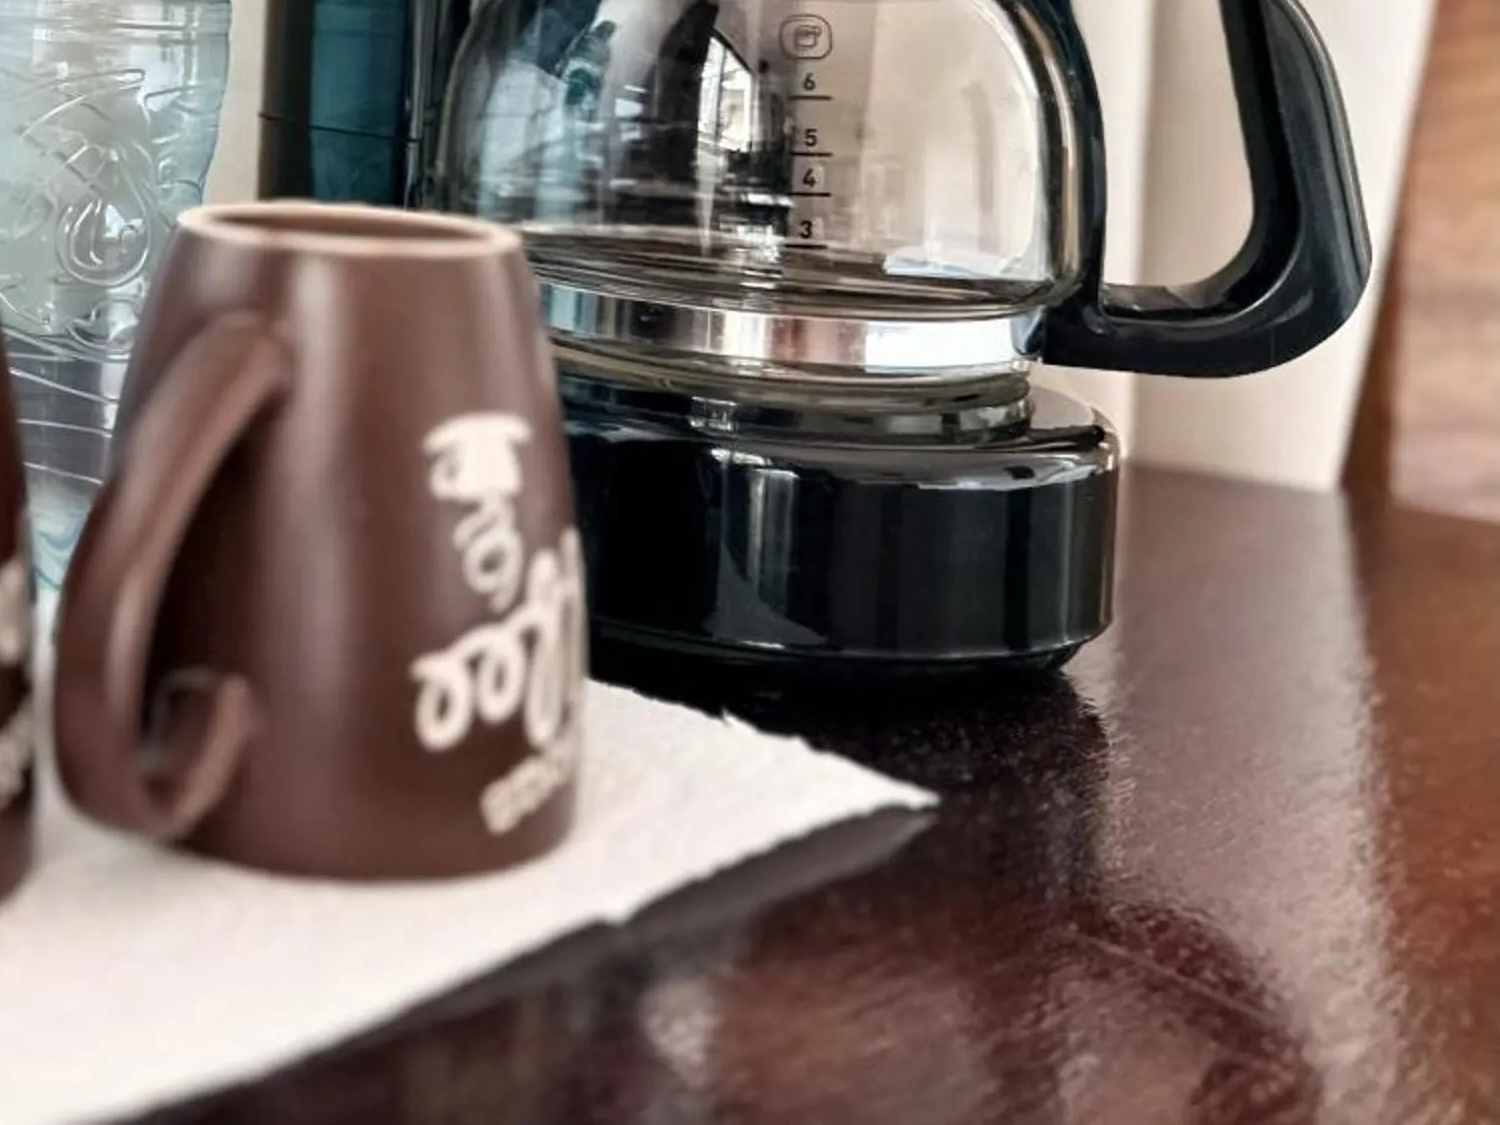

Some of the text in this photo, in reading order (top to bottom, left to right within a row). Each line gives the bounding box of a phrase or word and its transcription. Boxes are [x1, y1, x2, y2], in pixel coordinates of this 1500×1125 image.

[802, 73, 816, 90] 6
[804, 128, 818, 146] 5
[803, 169, 816, 187] 4
[800, 220, 813, 238] 3
